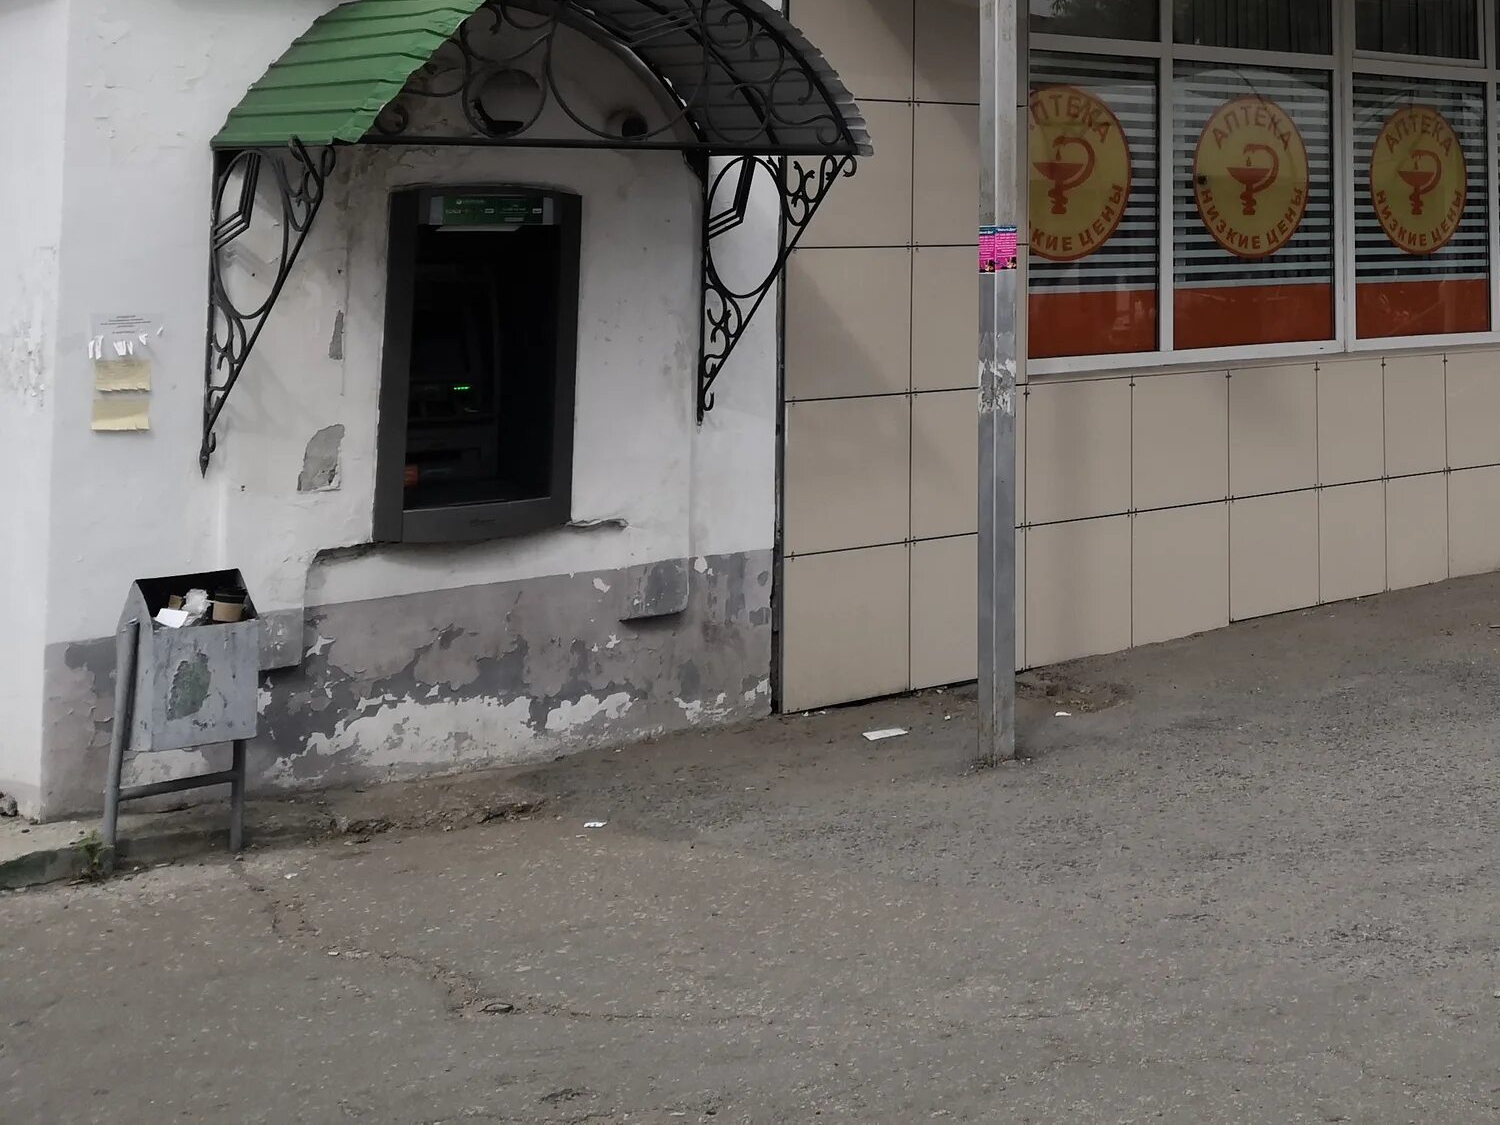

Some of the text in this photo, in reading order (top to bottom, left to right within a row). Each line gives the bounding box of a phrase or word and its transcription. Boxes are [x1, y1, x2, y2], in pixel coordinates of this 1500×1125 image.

[1030, 94, 1111, 144] ПТЕКА
[1213, 106, 1291, 150] АПТЕКА
[1385, 114, 1454, 156] АПТЕКА
[1028, 227, 1073, 252] КИЕ
[1079, 184, 1123, 250] ЦЕНЫ
[1200, 186, 1303, 250] НИЗКИЕ ЦЕНЫ
[1376, 189, 1462, 247] НИЗКИЕ ЦЕНЫ
